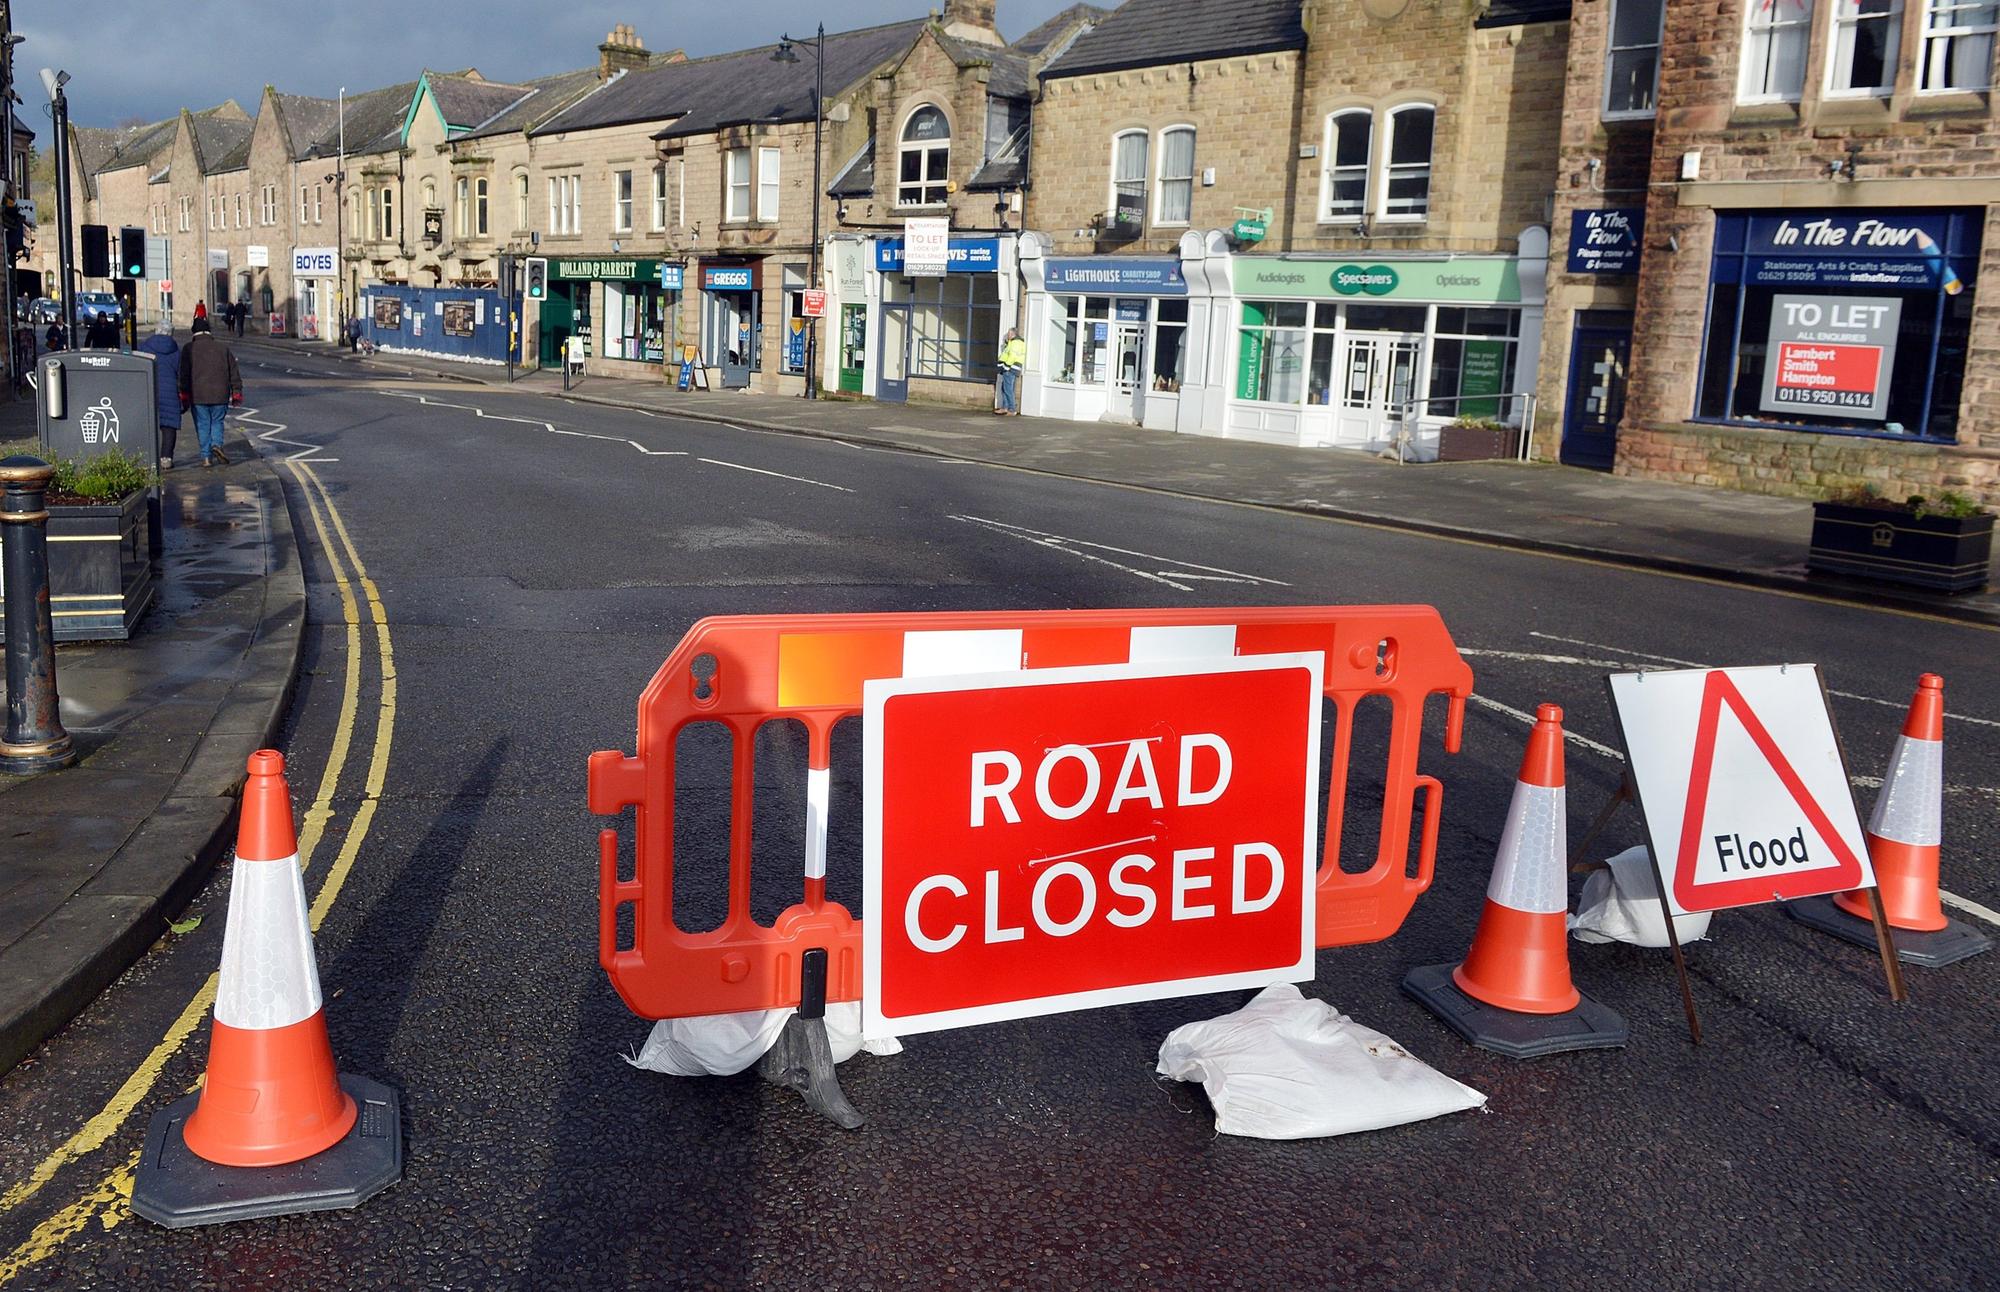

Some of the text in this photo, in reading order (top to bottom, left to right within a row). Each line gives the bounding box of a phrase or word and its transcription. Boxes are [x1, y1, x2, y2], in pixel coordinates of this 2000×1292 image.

[1585, 211, 1629, 228] In The
[1238, 224, 1264, 235] Specsavers
[1587, 228, 1623, 245] Flow
[1773, 218, 1918, 247] In The Flow
[911, 235, 943, 245] TO LET
[296, 255, 332, 270] BOYES
[560, 262, 637, 278] HOLLAND & BARRETT
[1764, 261, 1925, 273] Stationery, Arts & Crafts Supplies
[714, 272, 747, 286] GREGGS
[1256, 272, 1305, 285] Audiologists
[1337, 272, 1392, 286] Specsavers
[1436, 274, 1481, 287] Opticians
[1757, 271, 1785, 280] 01629
[1783, 303, 1890, 329] TO LET
[1797, 331, 1867, 342] ALL ENQUIRIES
[1784, 346, 1836, 361] Lambert
[1783, 358, 1818, 372] Smith
[1244, 365, 1256, 399] Contact
[1782, 371, 1836, 387] Hampton
[1780, 388, 1871, 406] 0115 950 1414
[969, 732, 1233, 828] ROAD
[1714, 826, 1809, 873] Flood
[904, 841, 1286, 954] CLOSED
